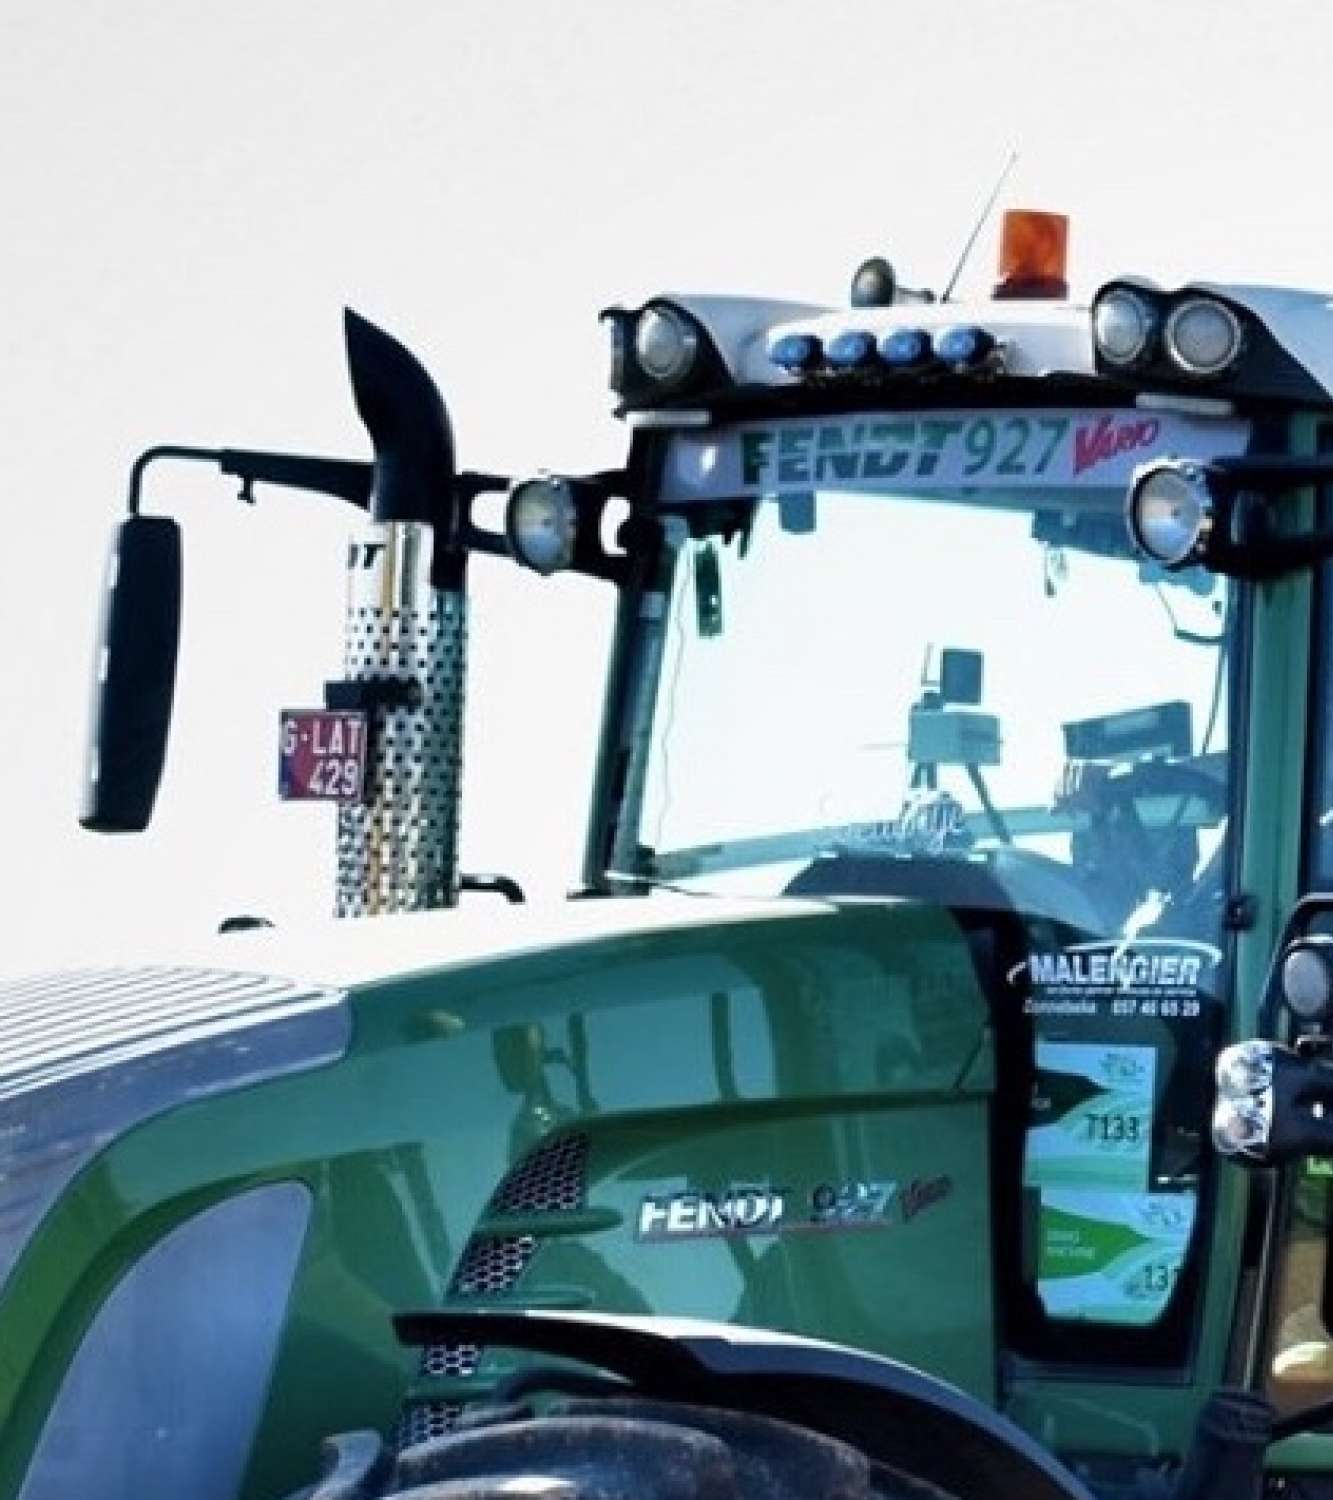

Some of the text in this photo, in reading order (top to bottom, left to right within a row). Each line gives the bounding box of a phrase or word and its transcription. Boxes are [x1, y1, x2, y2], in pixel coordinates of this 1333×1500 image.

[741, 417, 964, 485] FENDT
[961, 417, 1071, 476] 927
[308, 758, 359, 795] 429
[1029, 954, 1200, 985] MALENGIER
[640, 1188, 794, 1234] FENDT
[811, 1182, 897, 1225] 927
